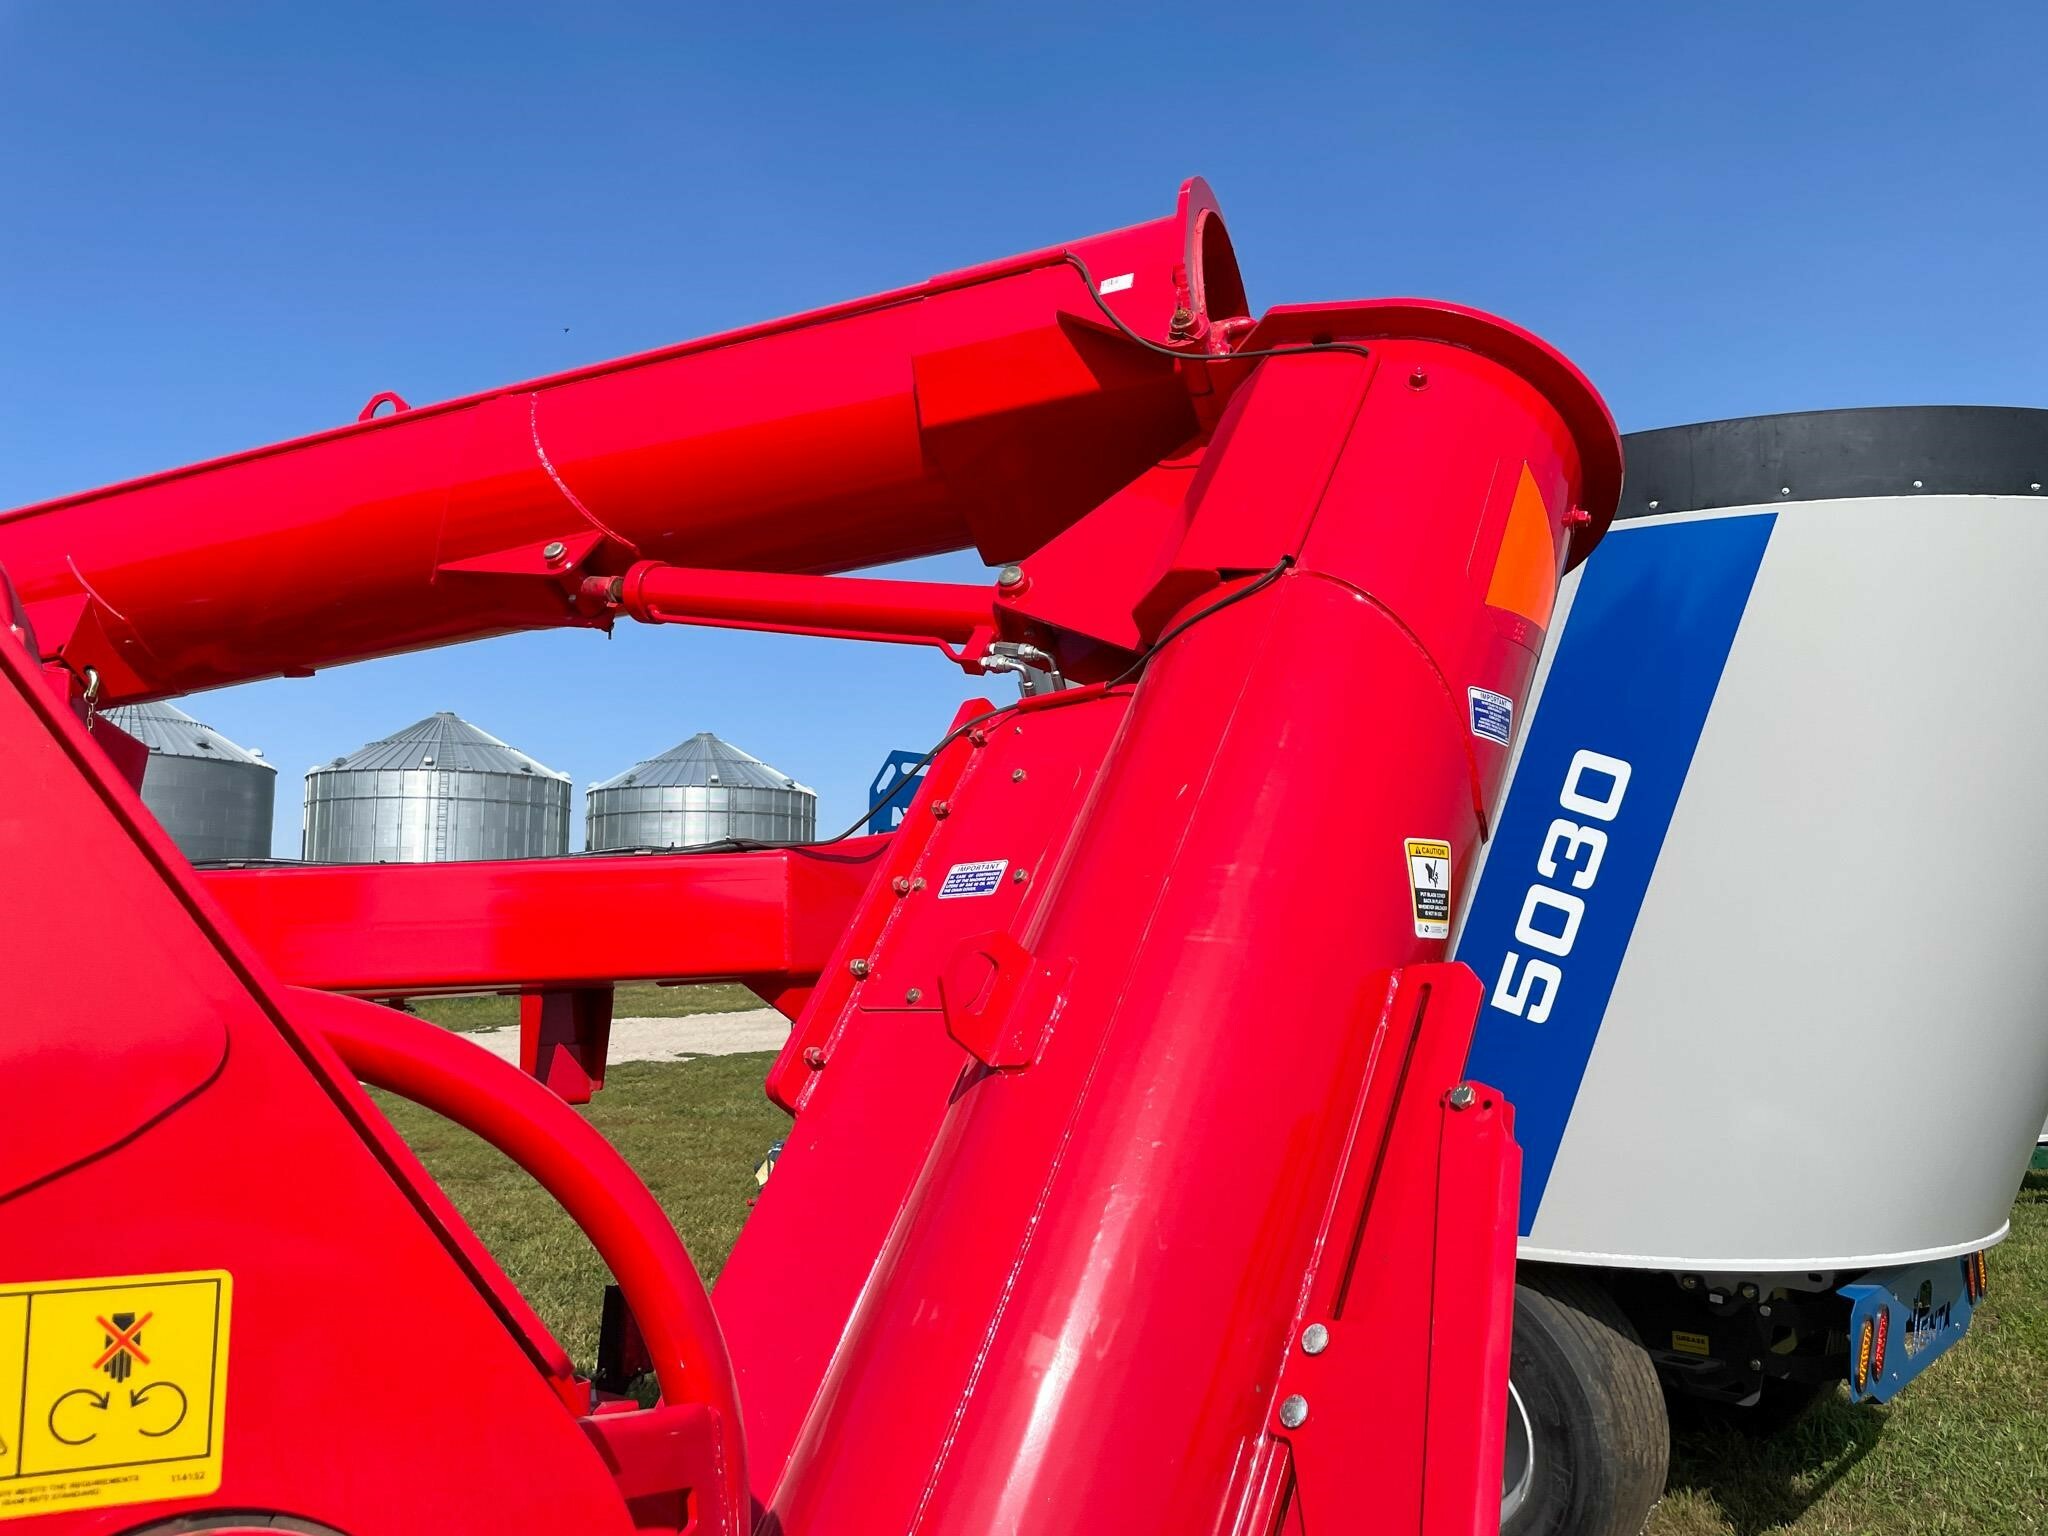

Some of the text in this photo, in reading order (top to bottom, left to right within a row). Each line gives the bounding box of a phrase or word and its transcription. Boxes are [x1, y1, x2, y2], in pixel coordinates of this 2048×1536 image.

[1480, 692, 1507, 706] IMPORTANT
[1422, 846, 1445, 856] CAUTION
[957, 863, 1000, 872] IMPORTANT
[1490, 748, 1632, 1024] 5030
